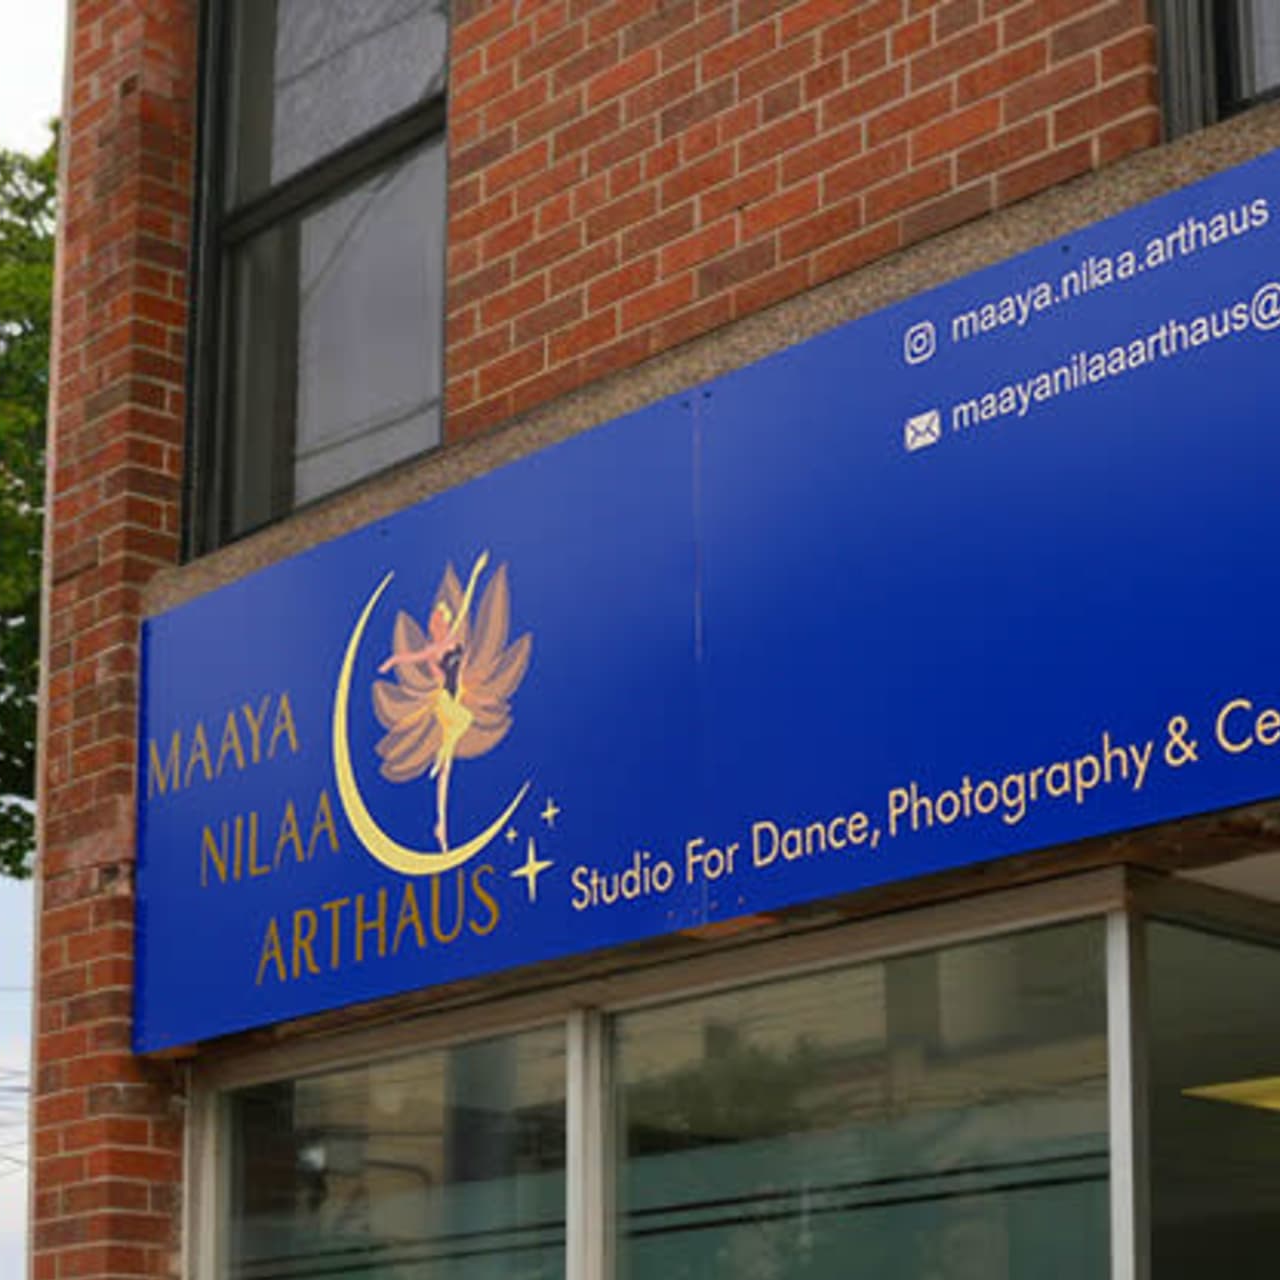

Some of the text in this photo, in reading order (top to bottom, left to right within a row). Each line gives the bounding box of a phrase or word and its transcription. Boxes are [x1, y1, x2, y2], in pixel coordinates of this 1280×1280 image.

[952, 198, 1270, 341] maaya.nilaa.arthaus
[148, 692, 300, 796] MAAYA
[200, 790, 341, 886] NILAA
[570, 850, 675, 911] Studio
[686, 836, 740, 884] For
[752, 810, 881, 868] Dance,
[888, 731, 1153, 838] Photography
[1164, 715, 1199, 767] &
[255, 862, 501, 986] ARTHAUS
